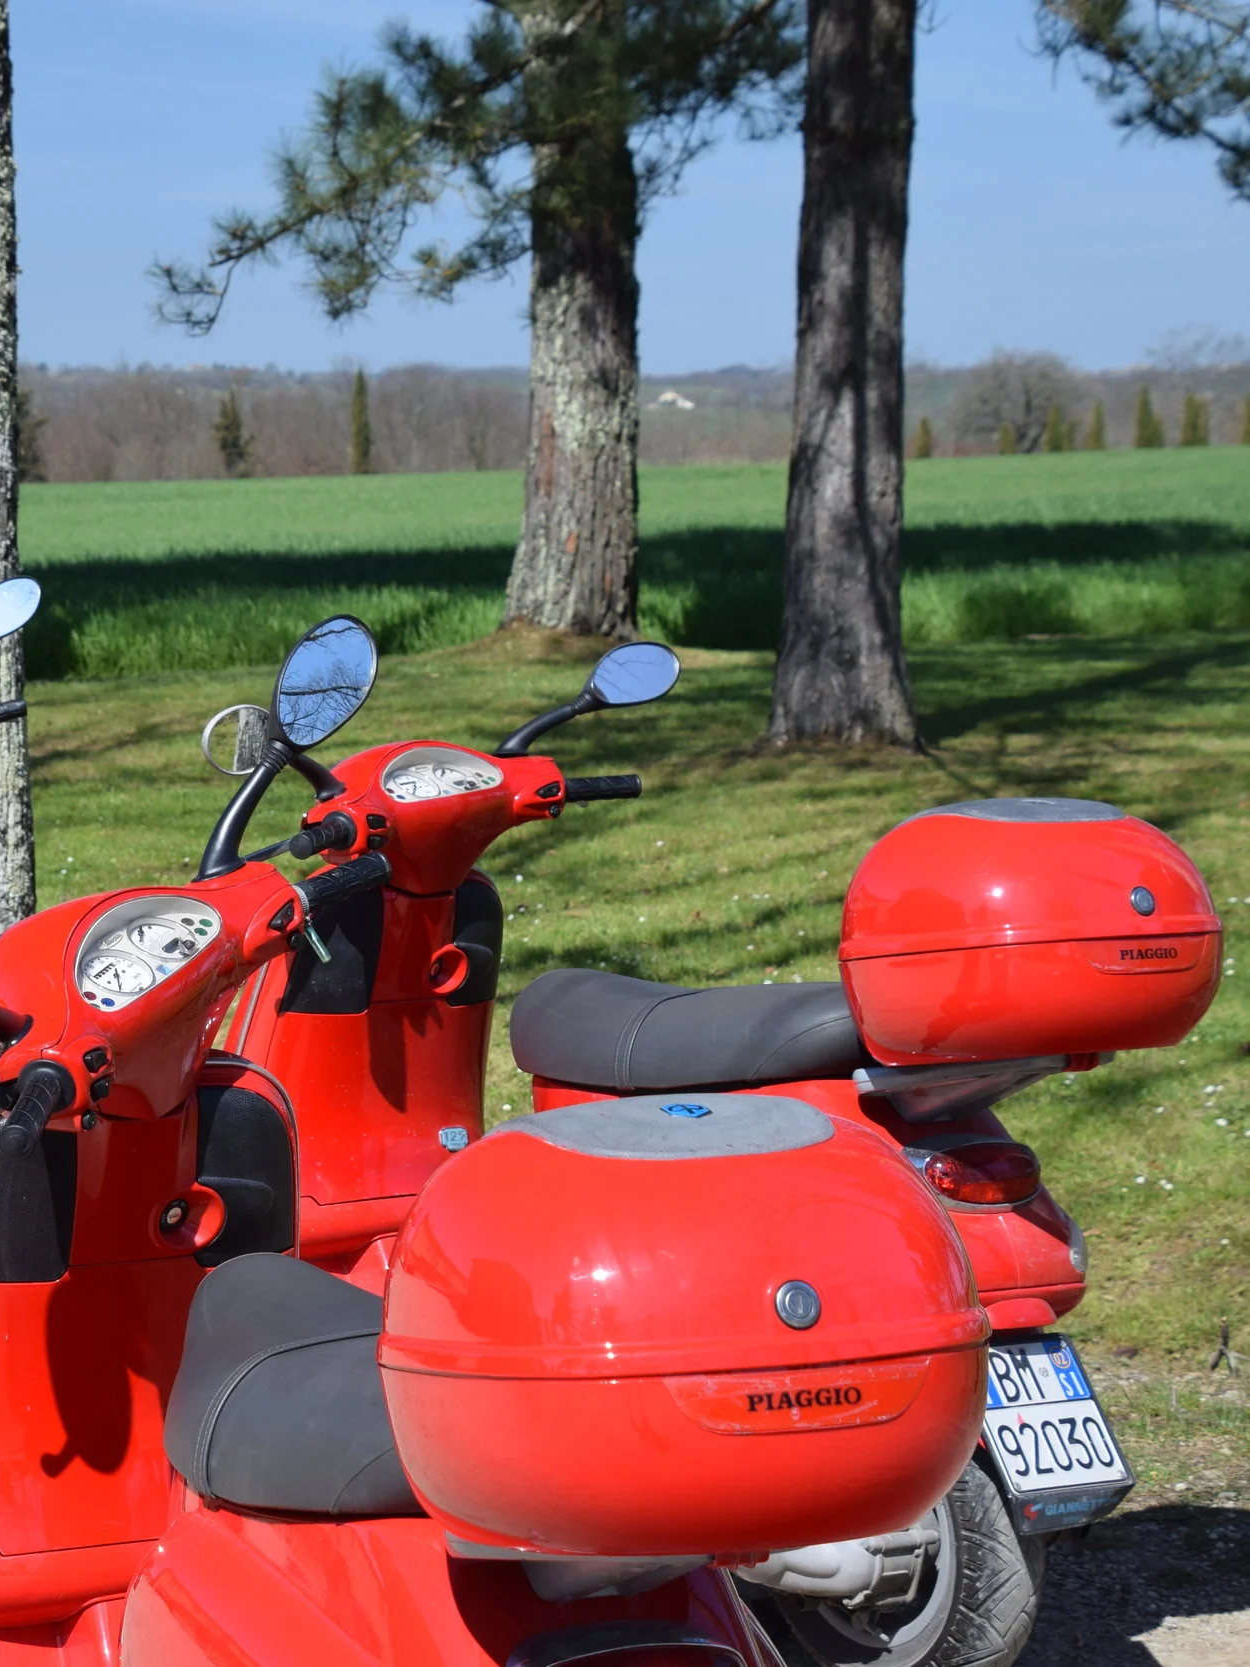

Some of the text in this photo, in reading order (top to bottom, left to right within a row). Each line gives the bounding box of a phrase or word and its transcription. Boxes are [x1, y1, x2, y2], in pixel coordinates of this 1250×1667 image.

[1119, 947, 1178, 960] PIAGGIO
[444, 1130, 466, 1142] 125
[989, 1347, 1085, 1403] BM SI
[747, 1386, 862, 1412] PIAGGIO
[997, 1416, 1115, 1478] 92030
